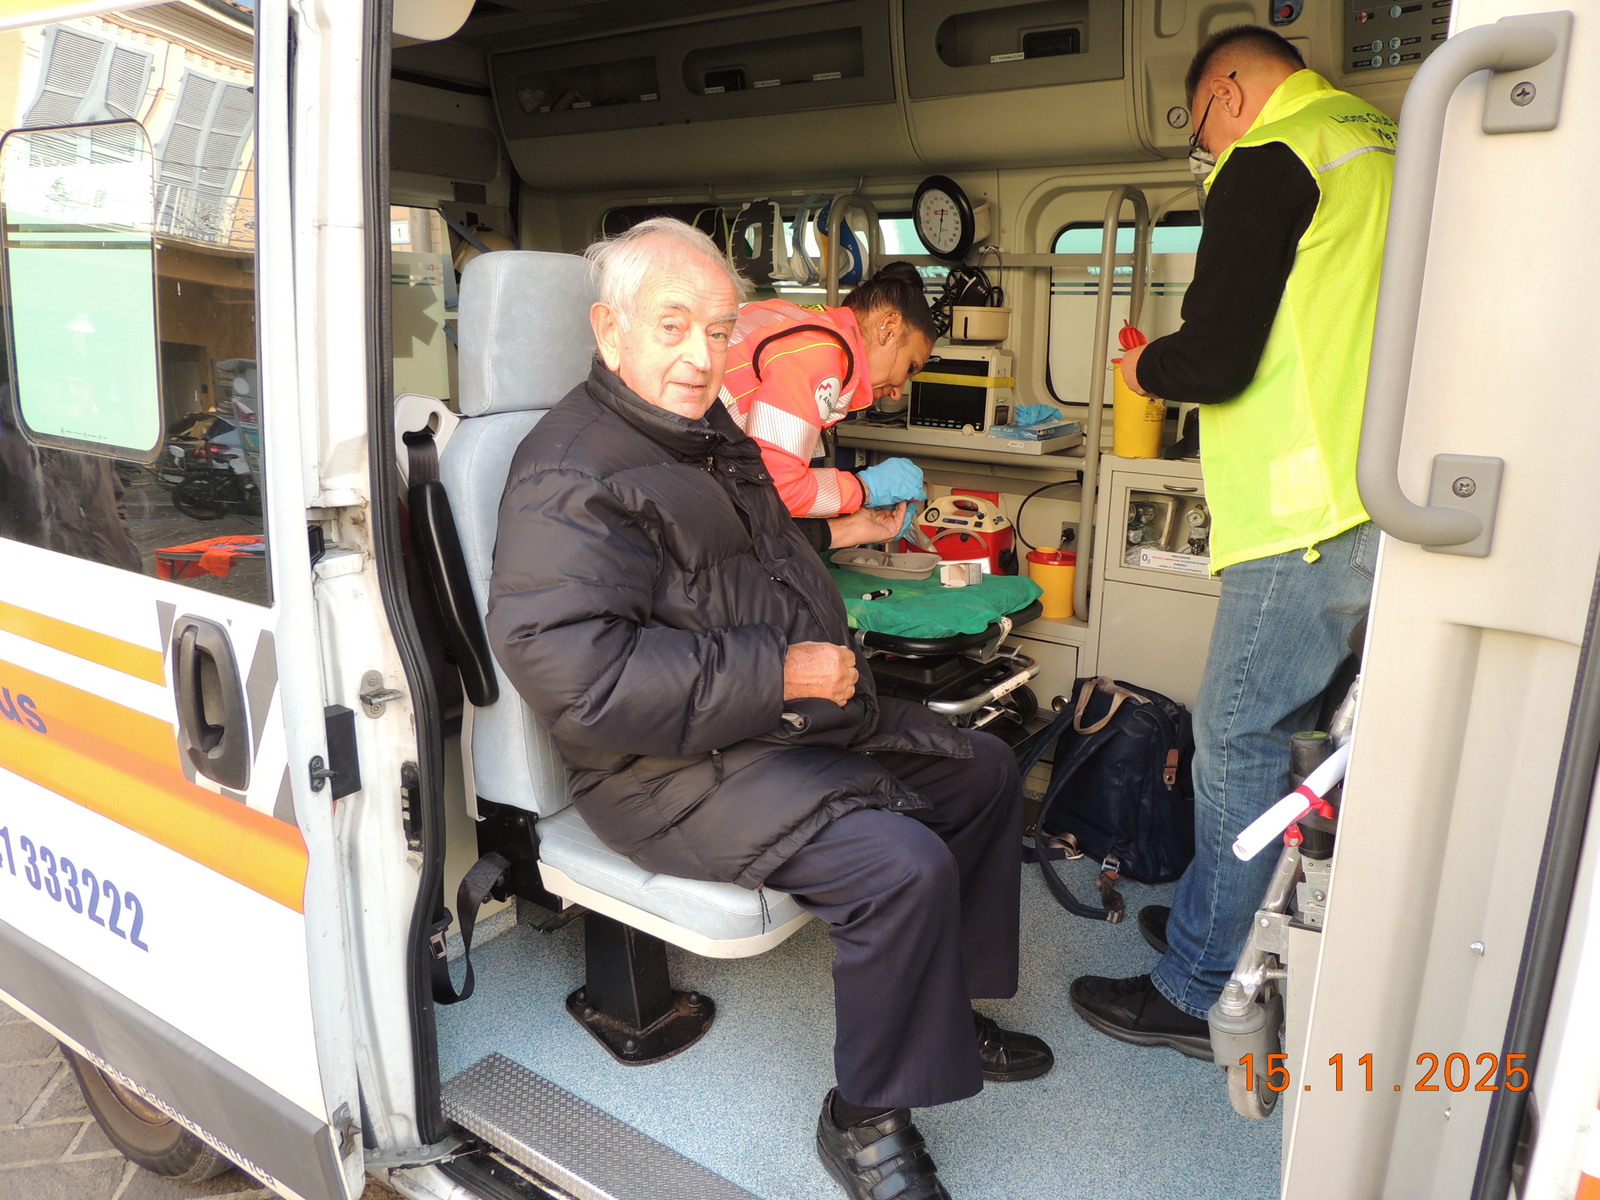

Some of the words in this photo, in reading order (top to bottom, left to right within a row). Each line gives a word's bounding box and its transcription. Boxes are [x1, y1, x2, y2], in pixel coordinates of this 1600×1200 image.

[1329, 115, 1369, 124] Lions
[1366, 113, 1394, 127] Club
[20, 835, 149, 953] 333222
